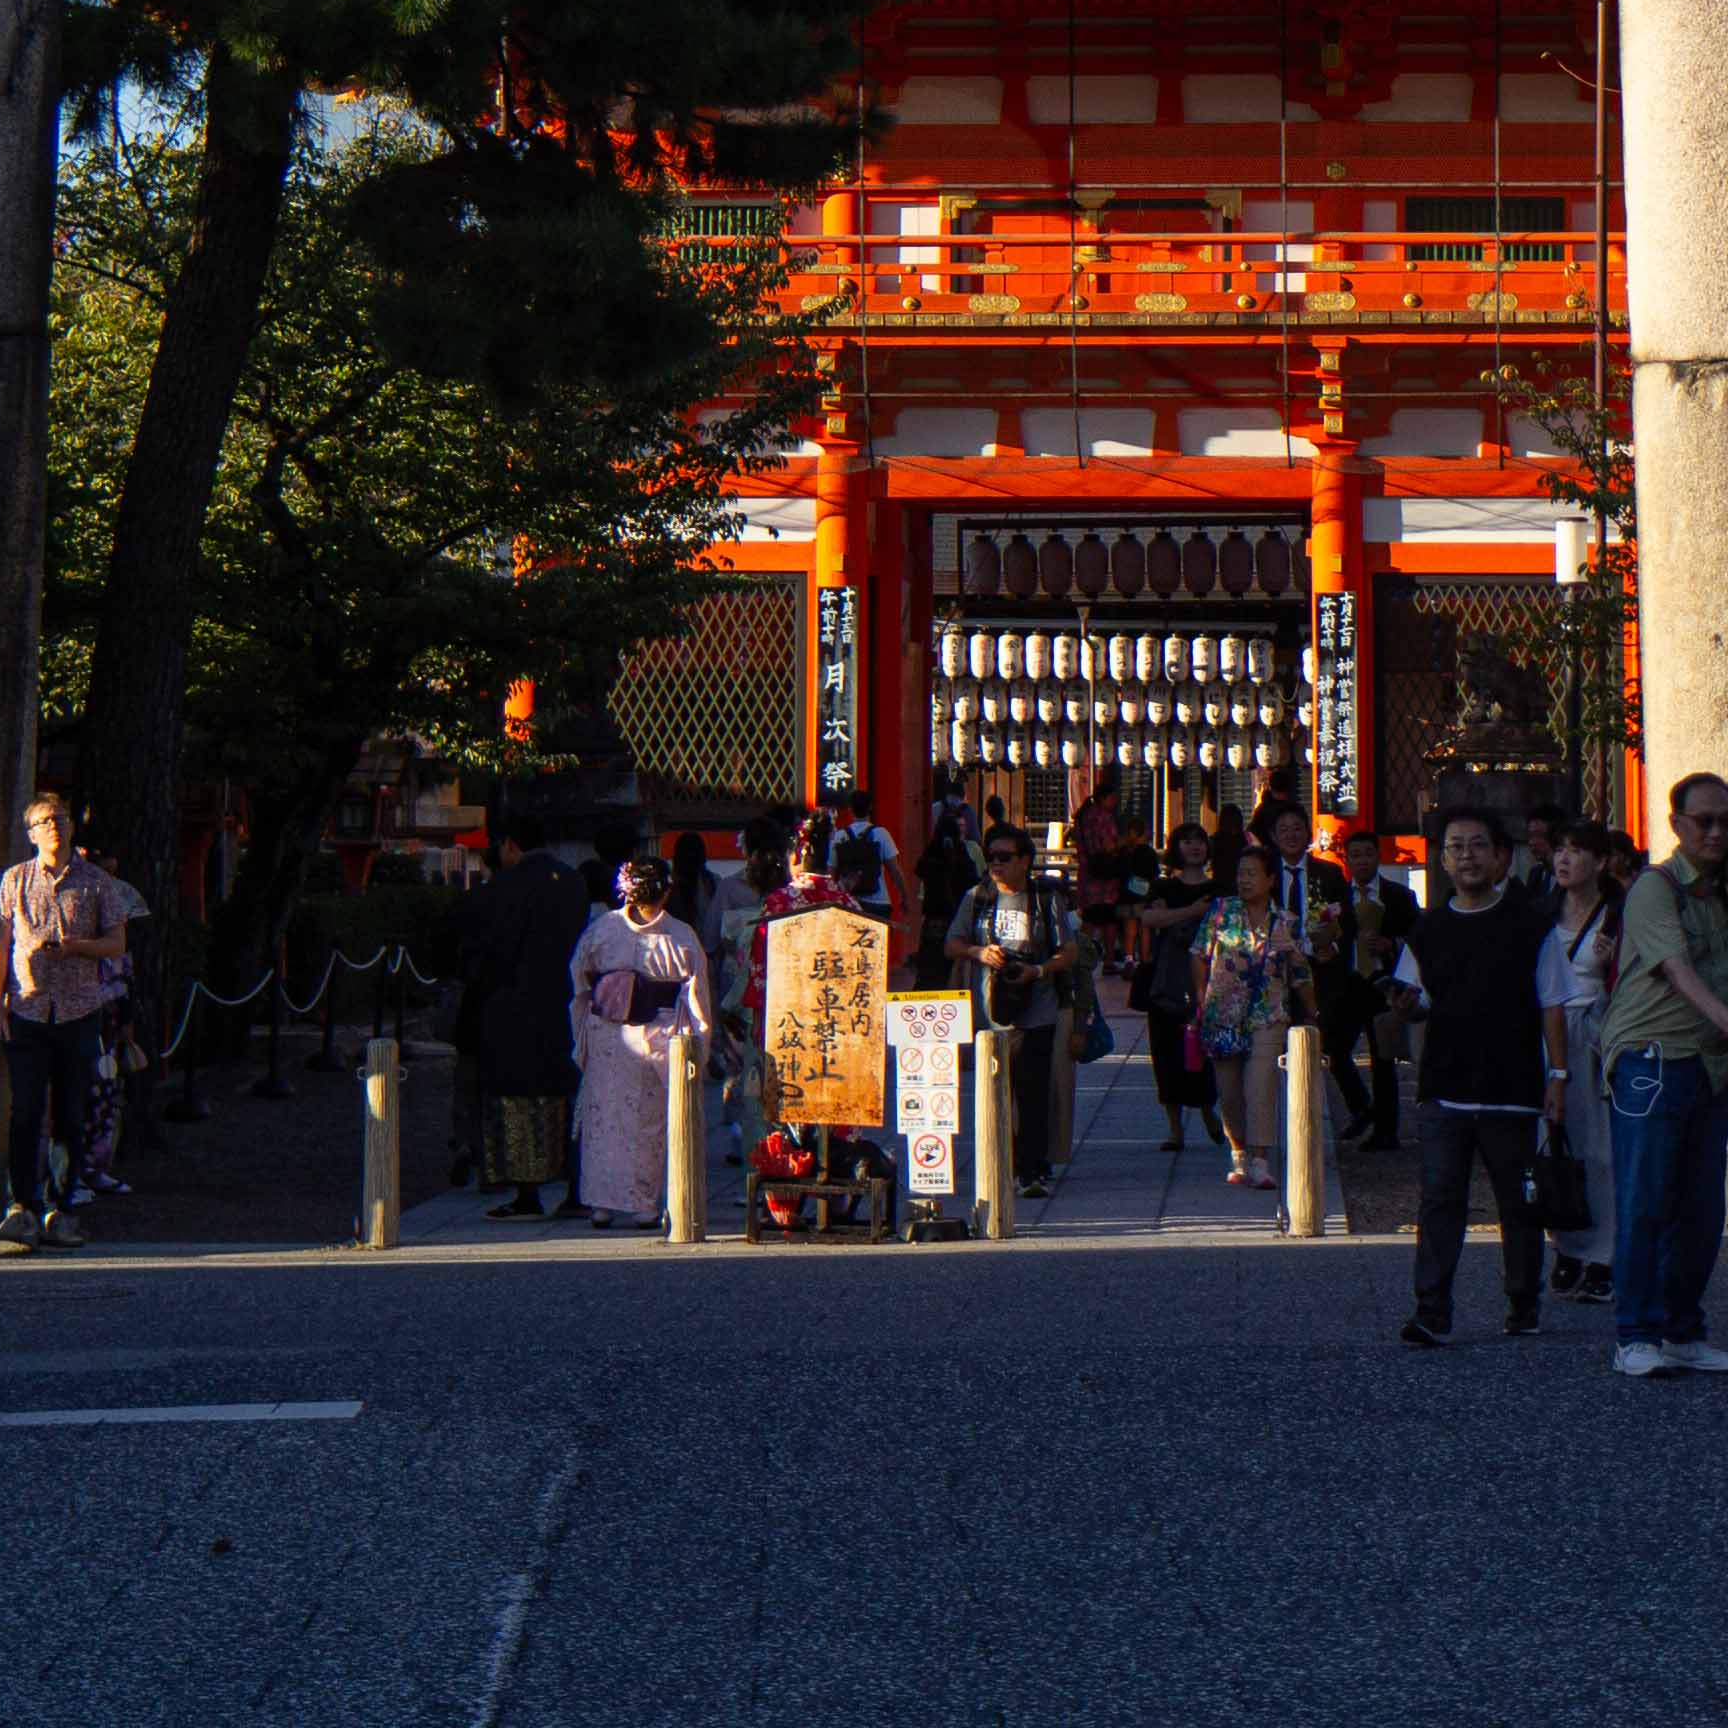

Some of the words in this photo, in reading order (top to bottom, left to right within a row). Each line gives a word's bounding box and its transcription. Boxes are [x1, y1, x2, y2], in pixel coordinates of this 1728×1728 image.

[823, 661, 852, 792] 月次祭
[805, 951, 848, 1082] 駐車禁止
